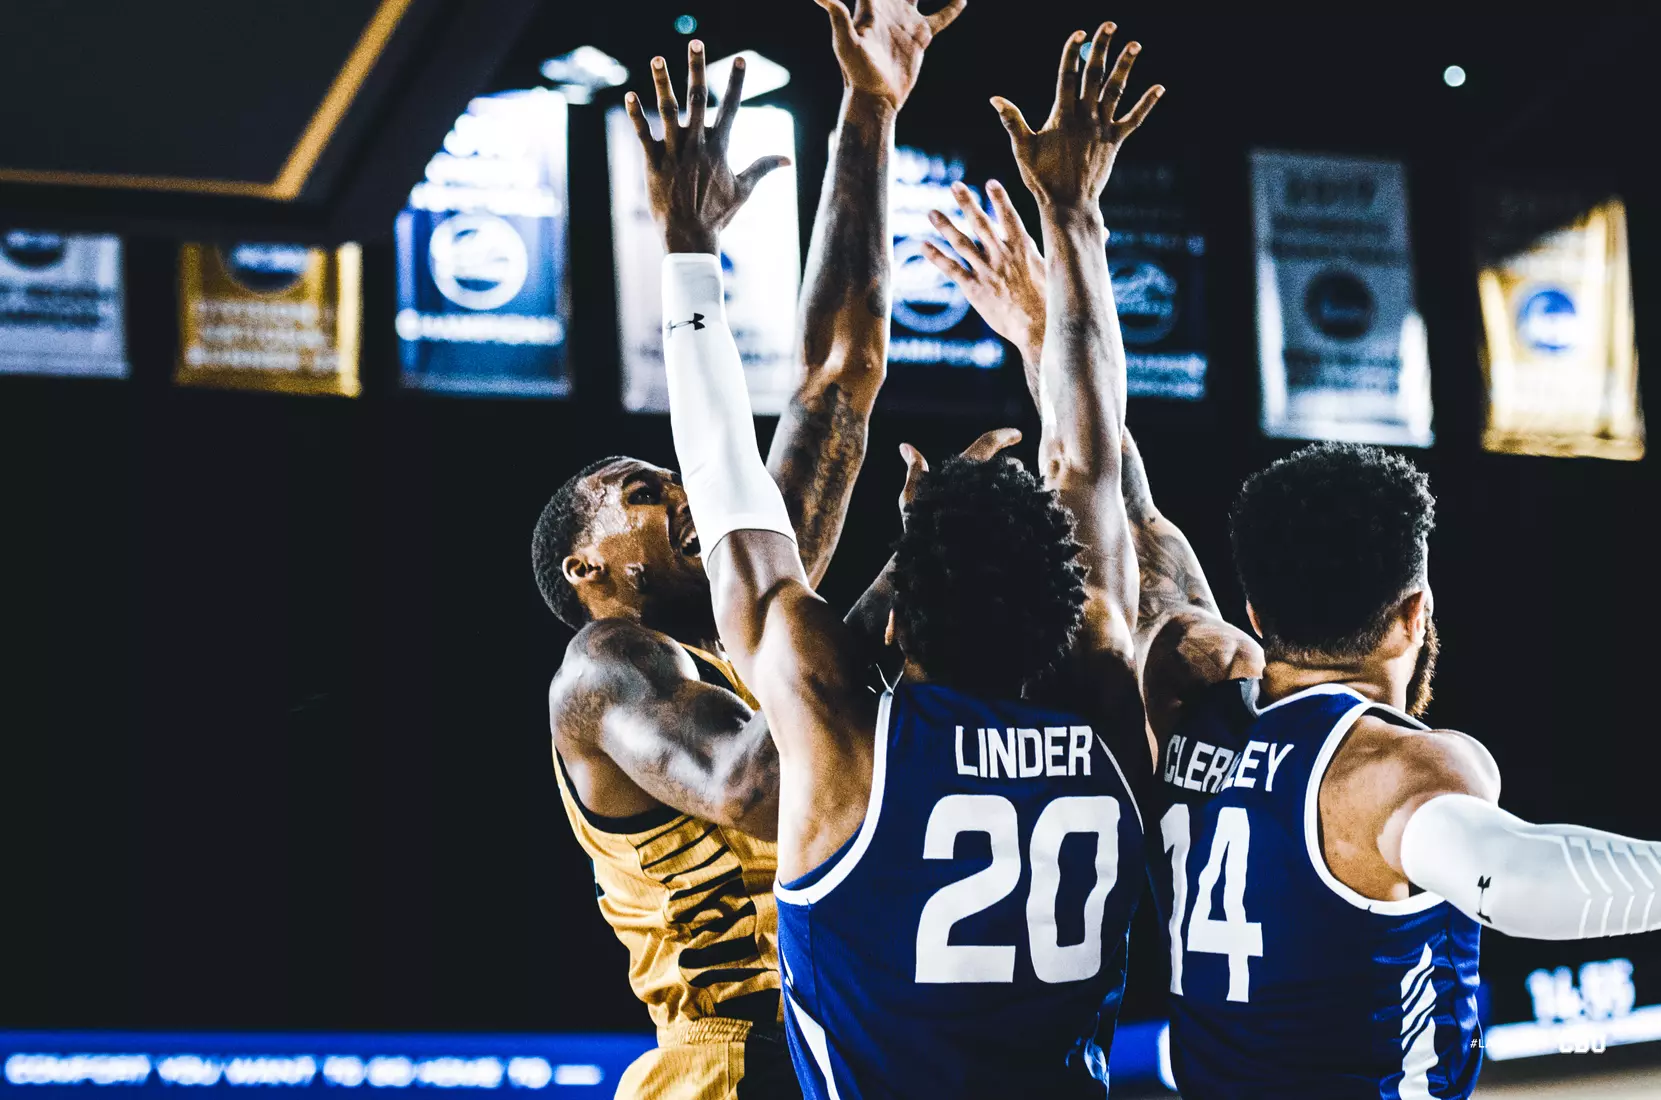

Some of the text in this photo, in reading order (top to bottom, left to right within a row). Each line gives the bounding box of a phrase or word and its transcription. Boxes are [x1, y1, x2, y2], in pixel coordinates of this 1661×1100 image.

[955, 725, 1093, 778] LINDER
[915, 794, 1120, 983] 20
[1160, 803, 1263, 1002] 14
